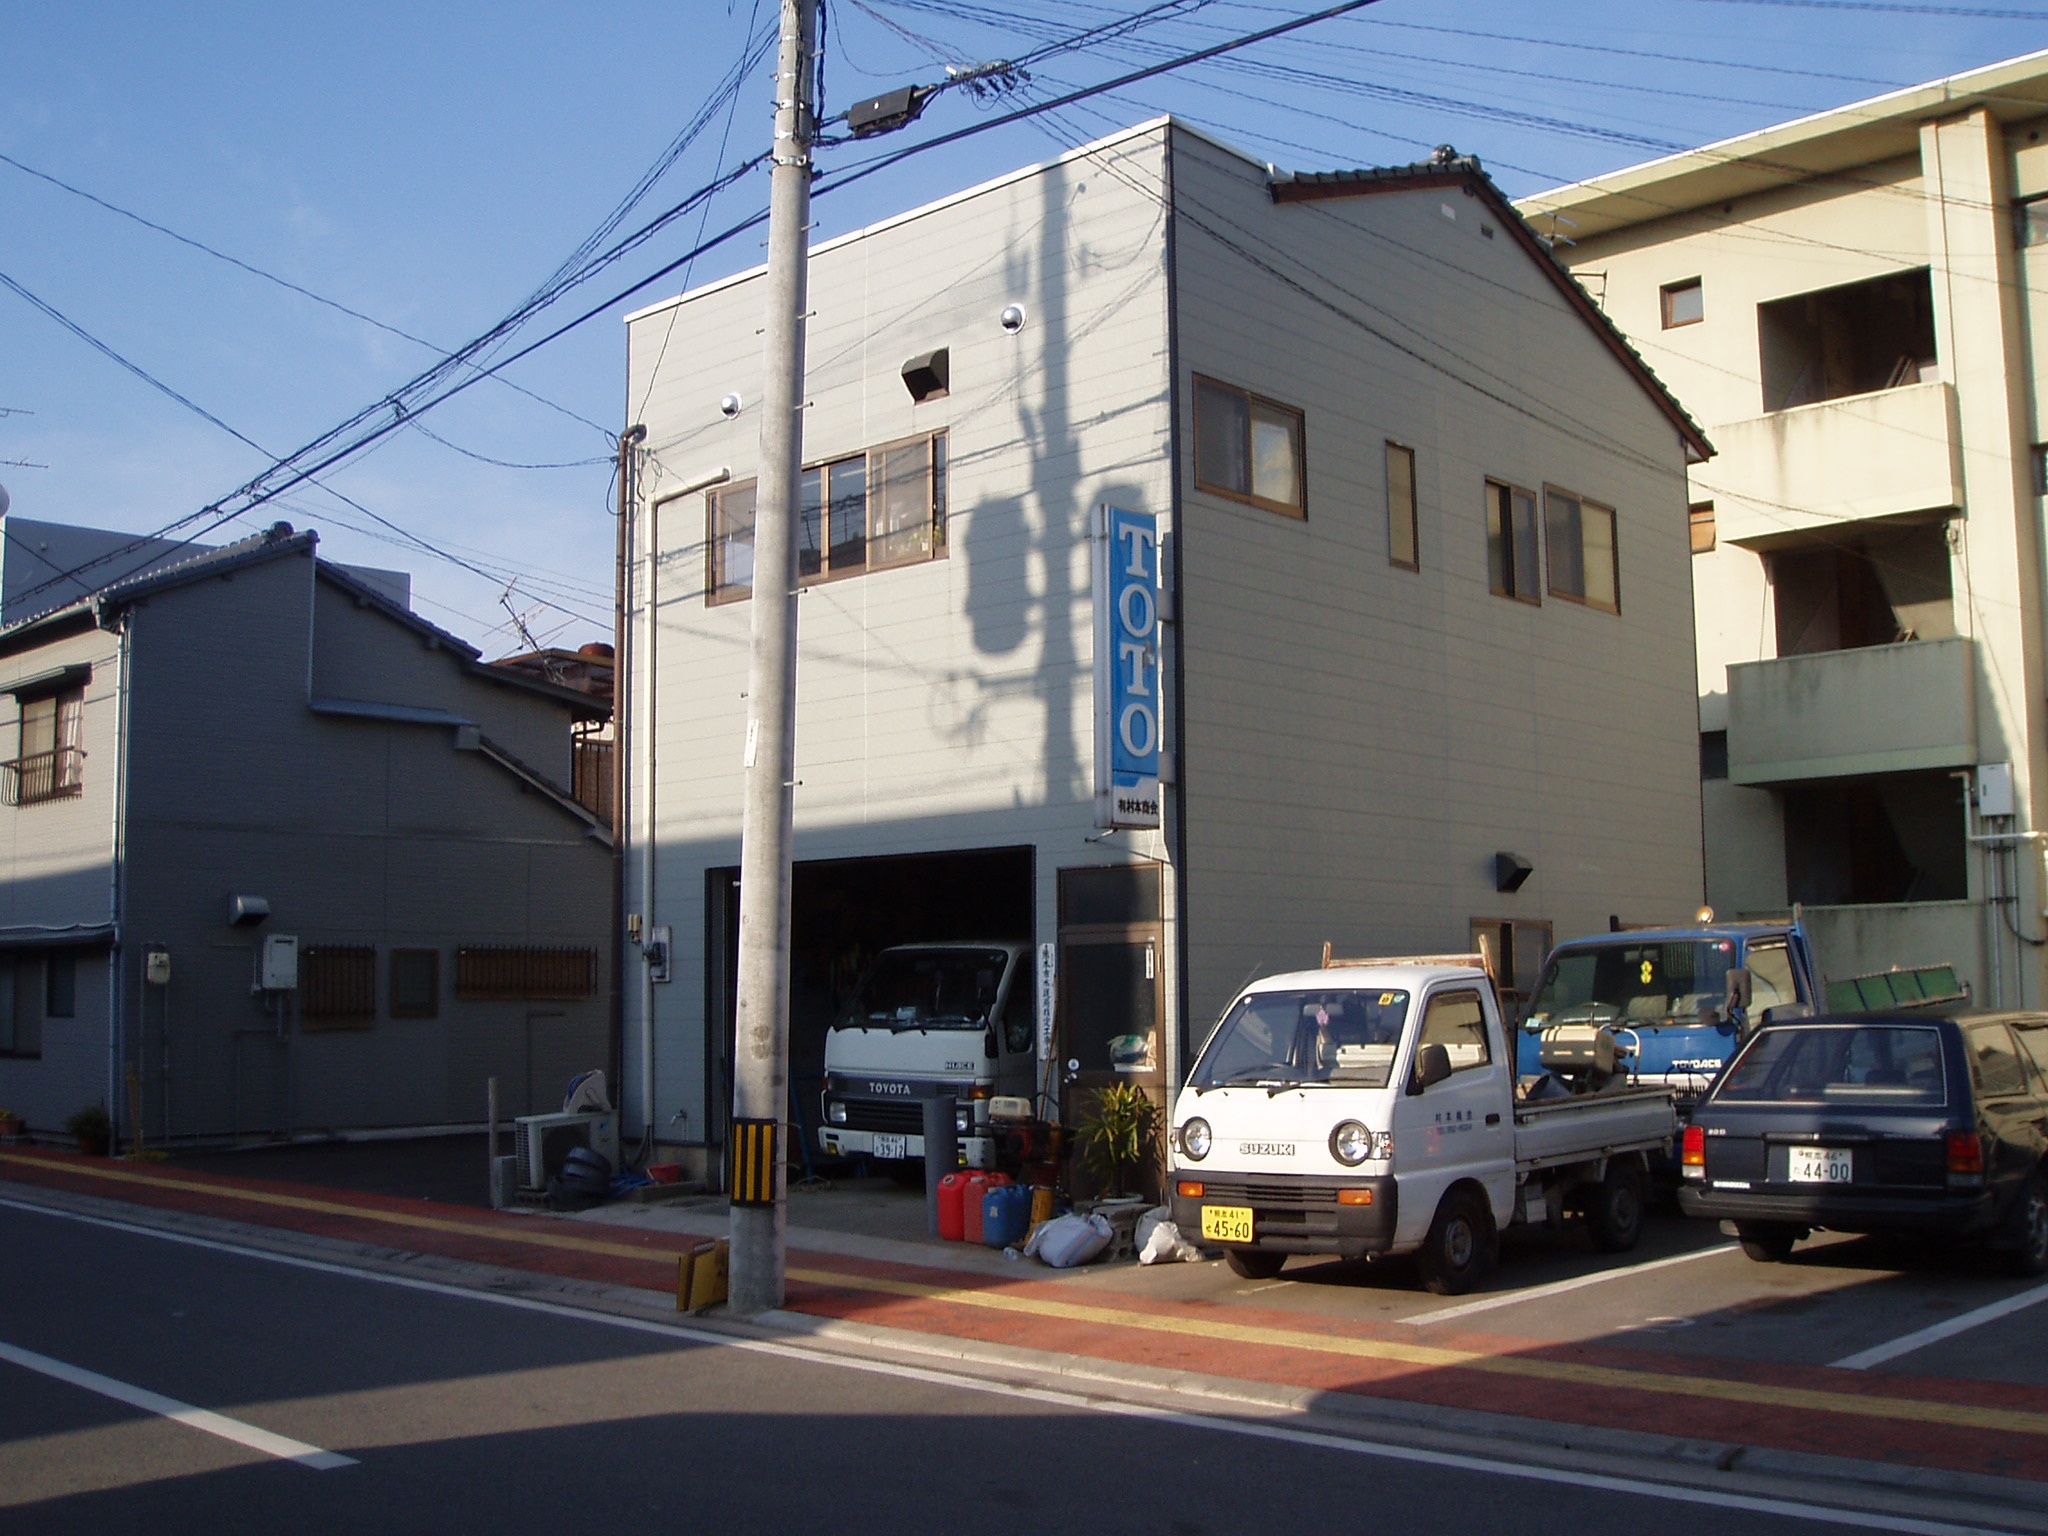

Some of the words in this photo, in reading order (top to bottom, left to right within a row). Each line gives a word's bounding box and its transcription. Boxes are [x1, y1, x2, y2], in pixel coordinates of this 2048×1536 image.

[1119, 523, 1156, 758] TOTO
[945, 1061, 974, 1070] HIACE
[1671, 1058, 1722, 1069] TOYOACE
[869, 1082, 911, 1096] TOYOTA
[1239, 1142, 1296, 1156] SUZUKI
[1803, 1162, 1849, 1180] 44-00
[1214, 1220, 1249, 1238] 45-60
